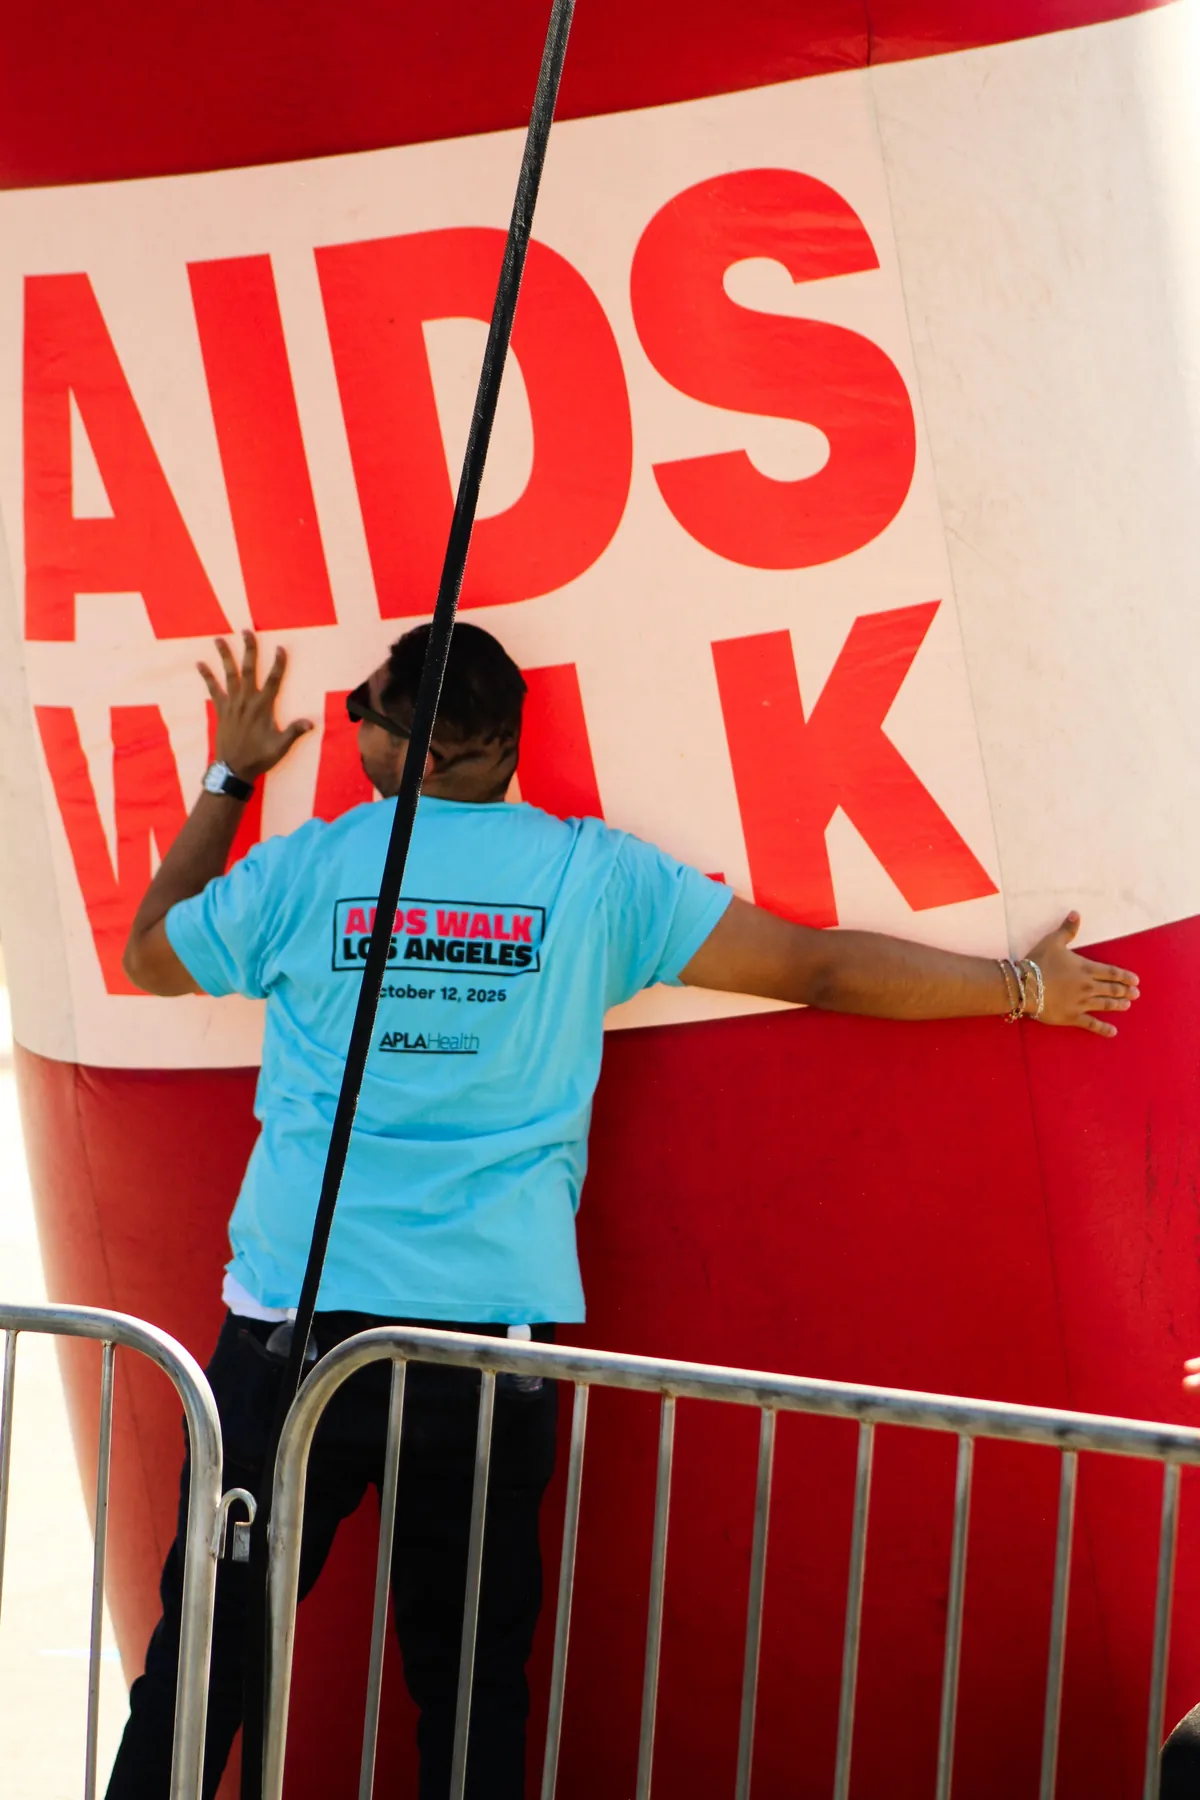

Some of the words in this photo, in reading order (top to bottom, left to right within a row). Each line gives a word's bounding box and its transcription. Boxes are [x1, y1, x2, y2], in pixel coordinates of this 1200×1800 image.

[23, 168, 916, 641] AIDS
[34, 599, 1000, 995] WK
[436, 910, 533, 943] WALK
[404, 937, 533, 967] ANGELES
[379, 984, 436, 1000] ctober
[440, 986, 461, 1003] 12,
[466, 987, 507, 1003] 2025
